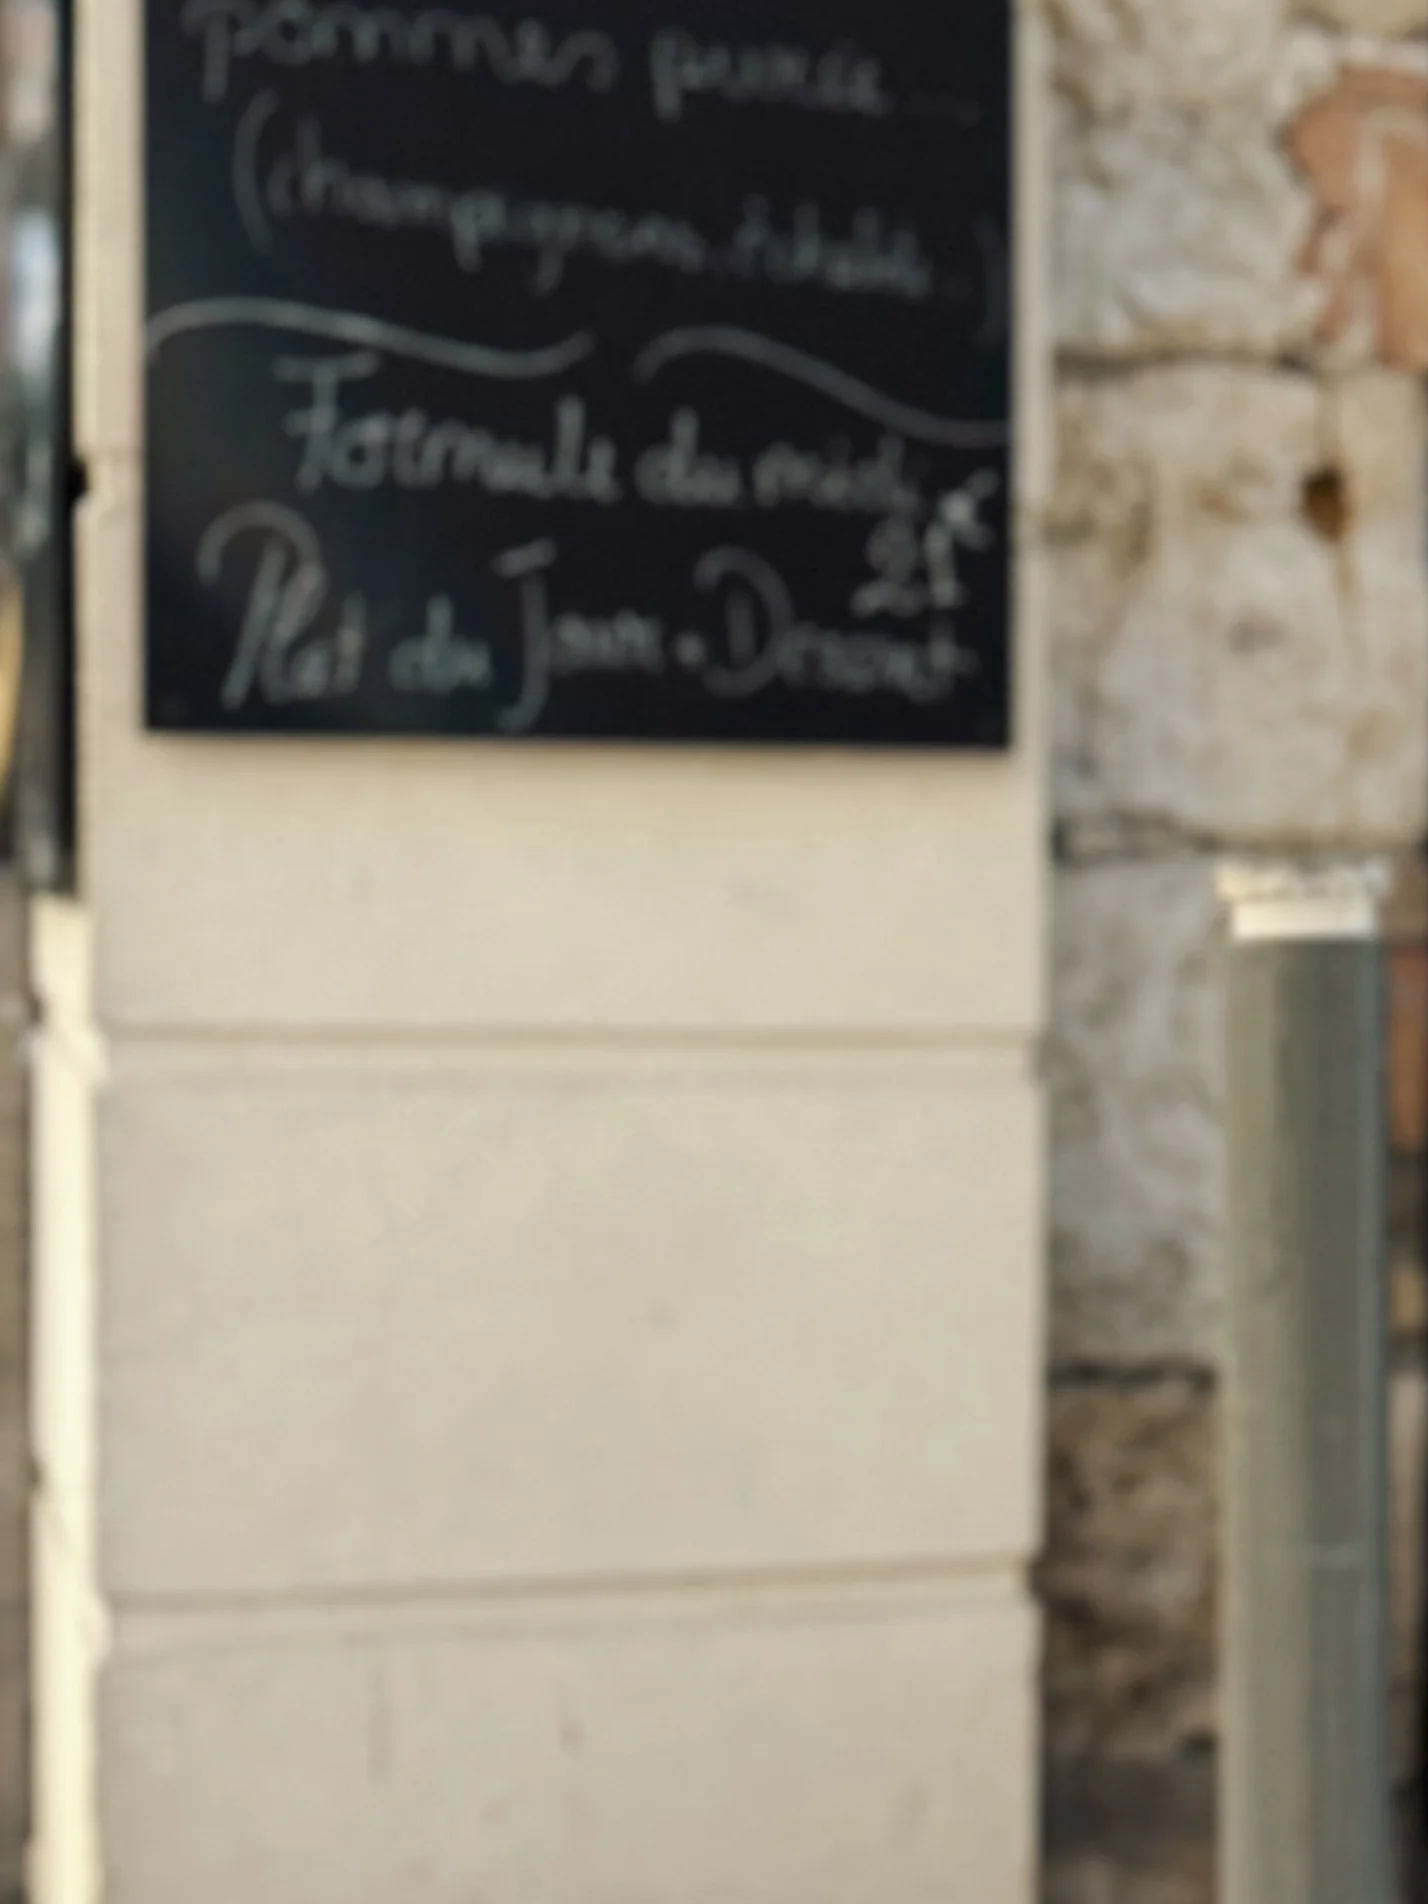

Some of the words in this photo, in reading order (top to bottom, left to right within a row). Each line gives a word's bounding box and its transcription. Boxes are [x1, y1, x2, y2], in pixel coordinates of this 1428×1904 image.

[273, 351, 621, 503] Formule
[635, 405, 746, 508] du
[387, 591, 493, 688] du
